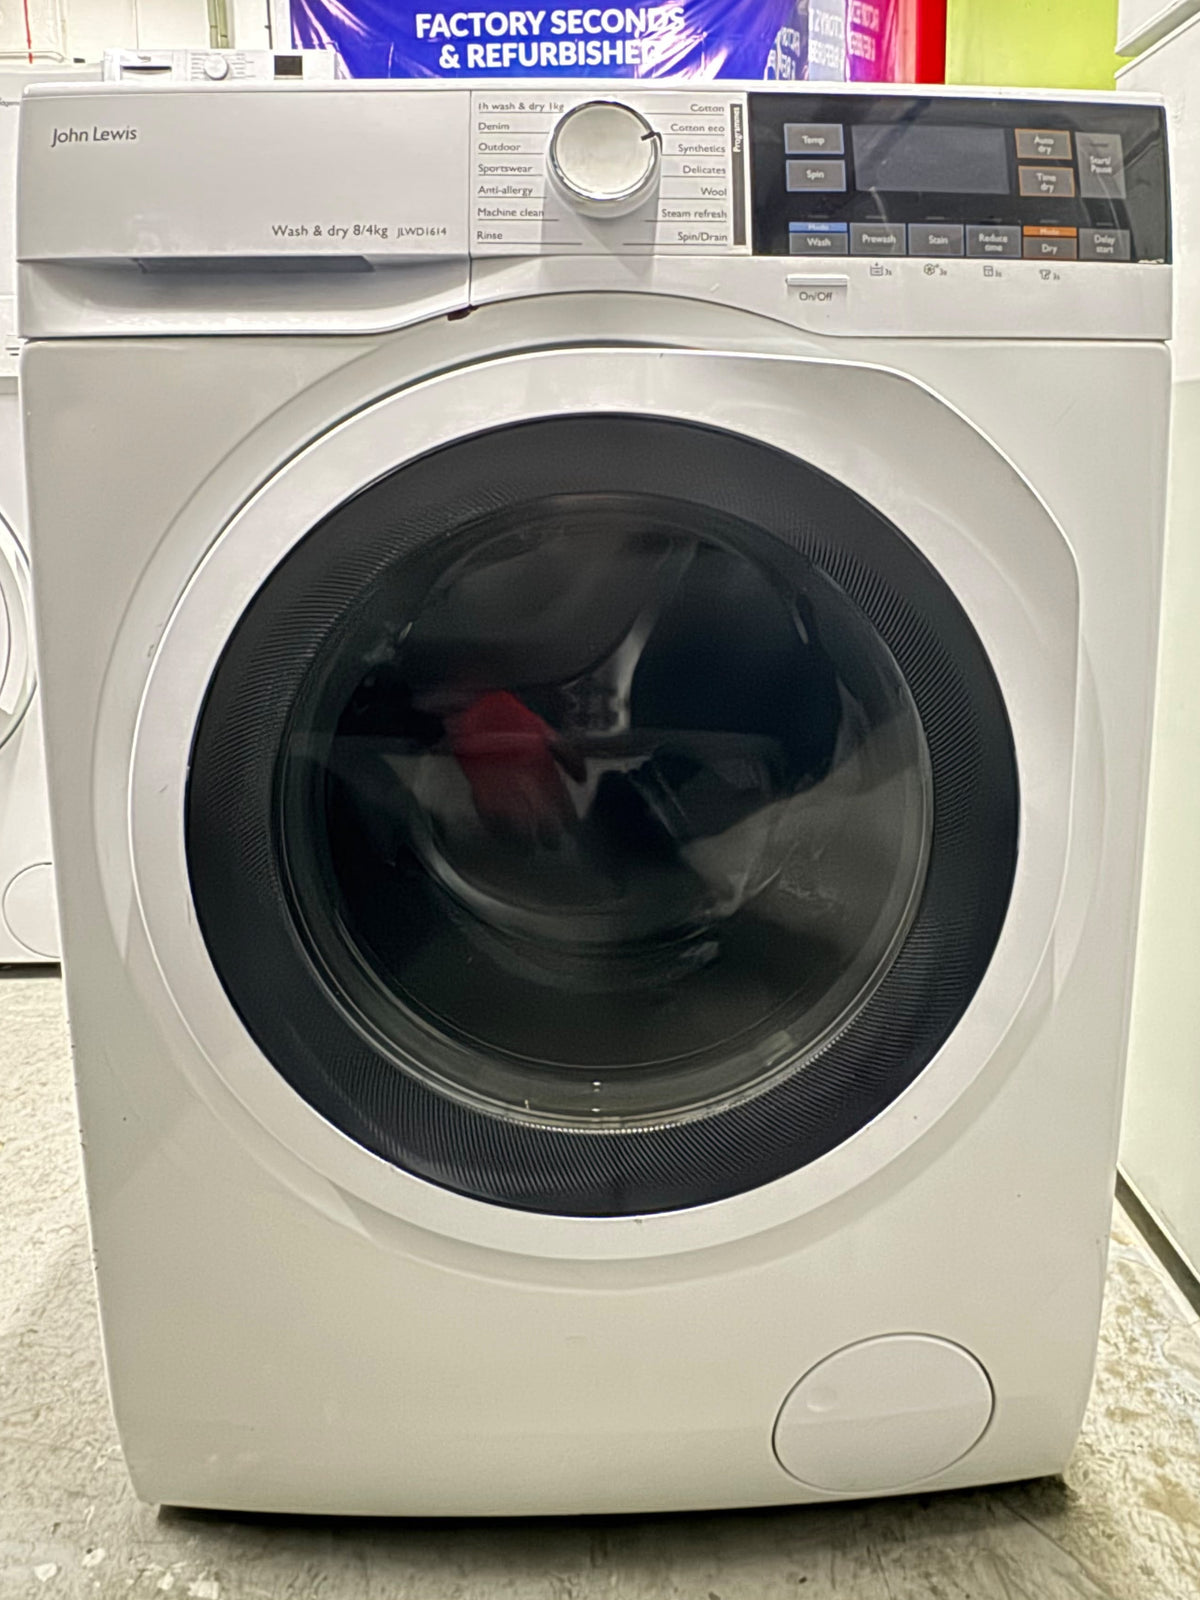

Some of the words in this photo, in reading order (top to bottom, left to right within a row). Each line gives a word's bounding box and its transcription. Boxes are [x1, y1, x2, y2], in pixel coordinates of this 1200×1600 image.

[415, 10, 546, 38] FACTORY
[550, 7, 685, 35] SECONDS
[439, 44, 461, 69] &
[492, 102, 515, 111] wash
[518, 102, 526, 111] &
[528, 102, 545, 113] dry
[549, 102, 564, 112] 1kg
[690, 103, 725, 113] Cotton
[478, 122, 510, 131] Denim
[670, 123, 705, 132] Cotton
[707, 124, 725, 132] eco
[51, 127, 89, 148] John
[92, 125, 137, 141] Lewis
[801, 135, 825, 146] Temp
[1033, 136, 1054, 145] Auto
[478, 142, 521, 151] Outdoor
[678, 144, 726, 154] Synthetics
[1037, 145, 1052, 155] dry
[478, 163, 533, 175] Sportswear
[682, 165, 726, 175] Delicates
[1090, 164, 1112, 174] Pause
[806, 169, 825, 181] Spin
[1036, 173, 1056, 182] Time
[477, 185, 533, 197] Anti-allergy
[700, 187, 727, 196] Wool
[1040, 182, 1054, 193] dry
[477, 207, 518, 217] Machine
[519, 207, 545, 217] clean
[661, 208, 691, 218] Steam
[694, 209, 728, 219] refresh
[272, 224, 309, 237] Wash
[313, 225, 323, 237] &
[327, 225, 349, 240] dry
[352, 224, 389, 240] 8/4kg
[397, 227, 447, 239] JLWD1614
[476, 231, 503, 240] Rinse
[677, 231, 728, 242] Spin/Drain
[807, 237, 831, 247] Wash
[861, 234, 897, 244] Prewash
[928, 235, 949, 245] Stain
[978, 233, 1009, 243] Reduce
[1094, 234, 1115, 245] Delay
[984, 243, 1003, 252] time
[1041, 244, 1058, 255] Dry
[1096, 244, 1114, 254] start
[798, 291, 833, 302] On/Off
